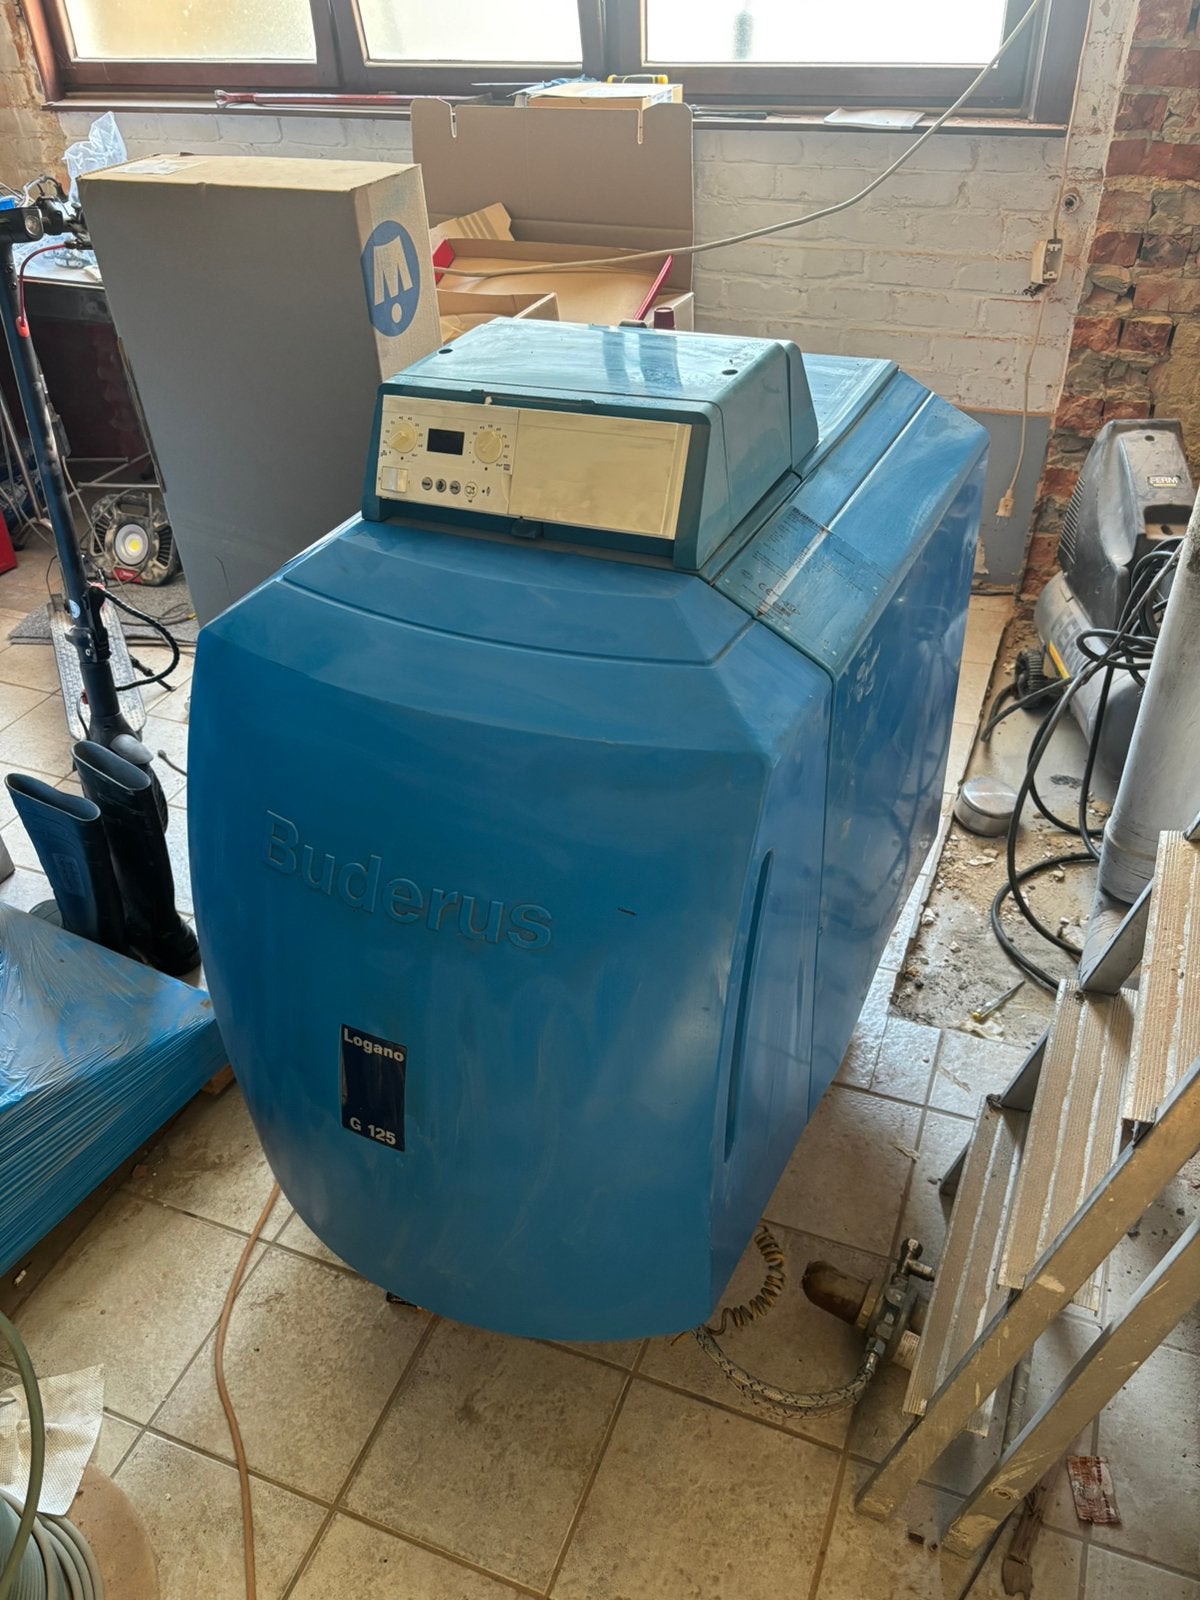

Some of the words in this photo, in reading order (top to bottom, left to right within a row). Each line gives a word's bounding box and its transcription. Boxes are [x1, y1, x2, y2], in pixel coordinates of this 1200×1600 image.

[1150, 476, 1178, 484] FERM
[263, 809, 552, 950] Buderus
[343, 1027, 405, 1062] Logano
[349, 1117, 362, 1132] G
[367, 1124, 397, 1145] 125
